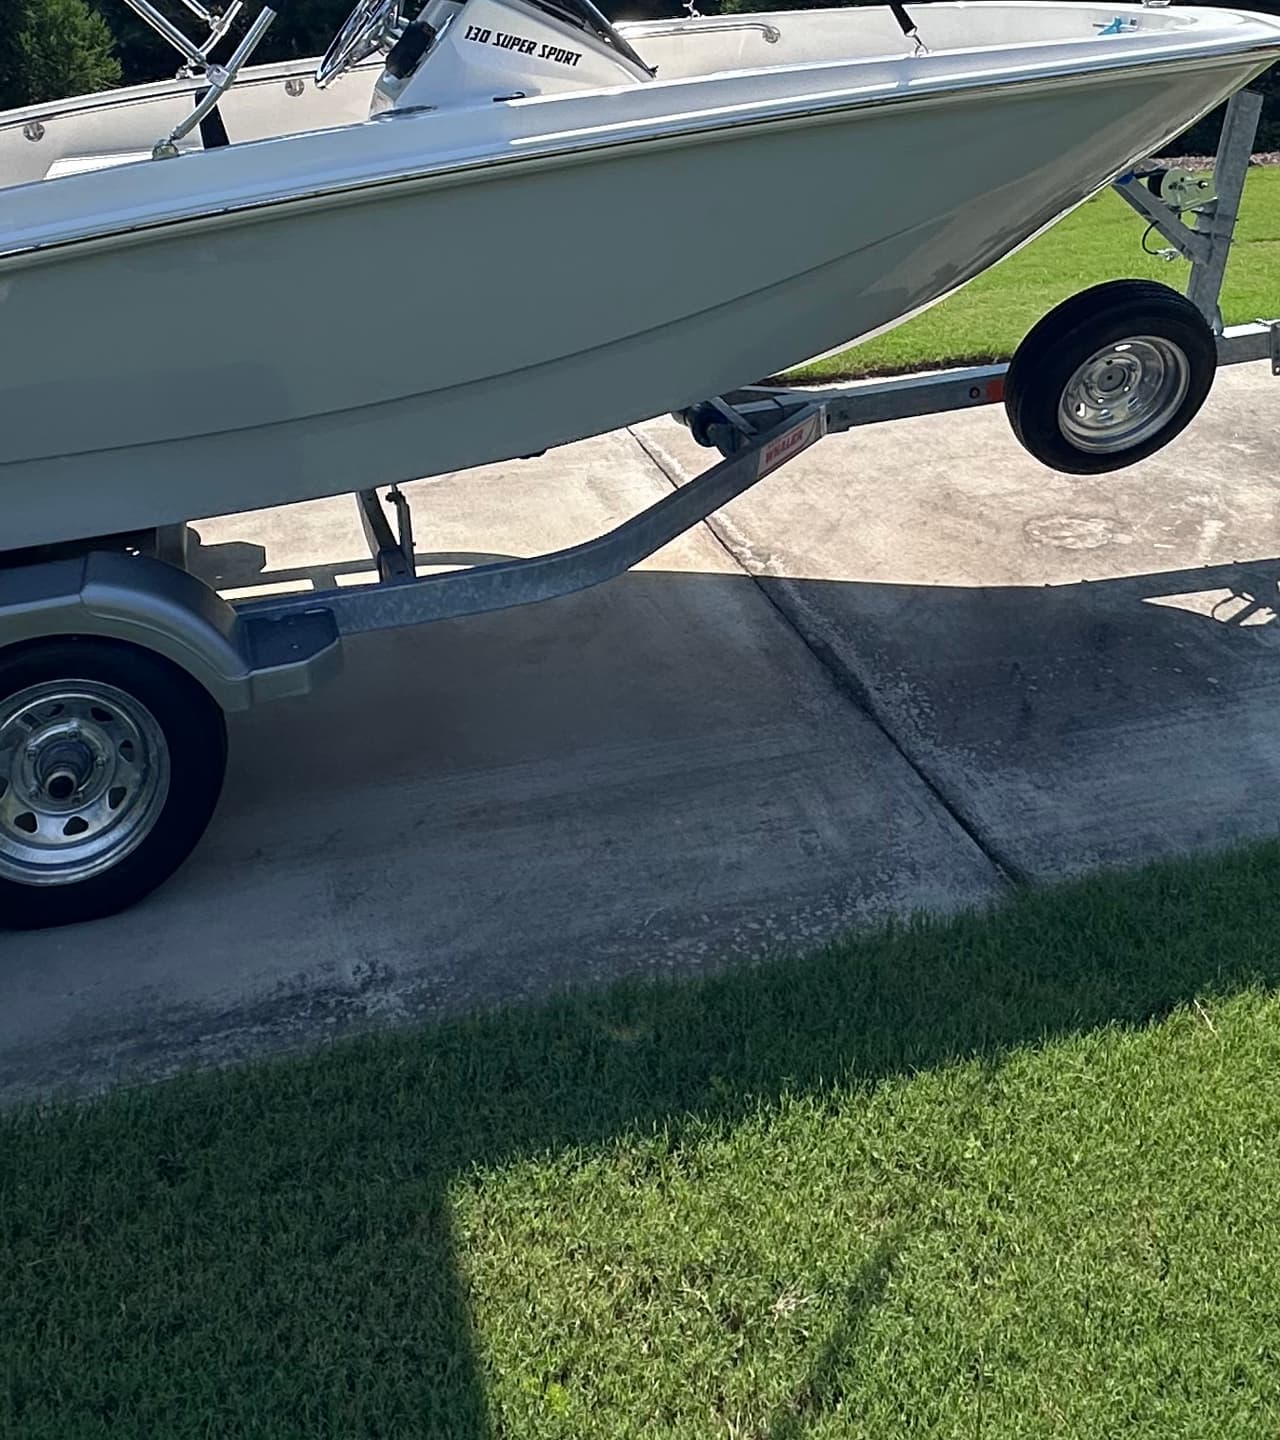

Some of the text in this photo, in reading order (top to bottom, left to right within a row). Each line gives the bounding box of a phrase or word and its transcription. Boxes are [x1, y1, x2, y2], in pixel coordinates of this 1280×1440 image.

[464, 25, 583, 67] 130 SUPER SPORT
